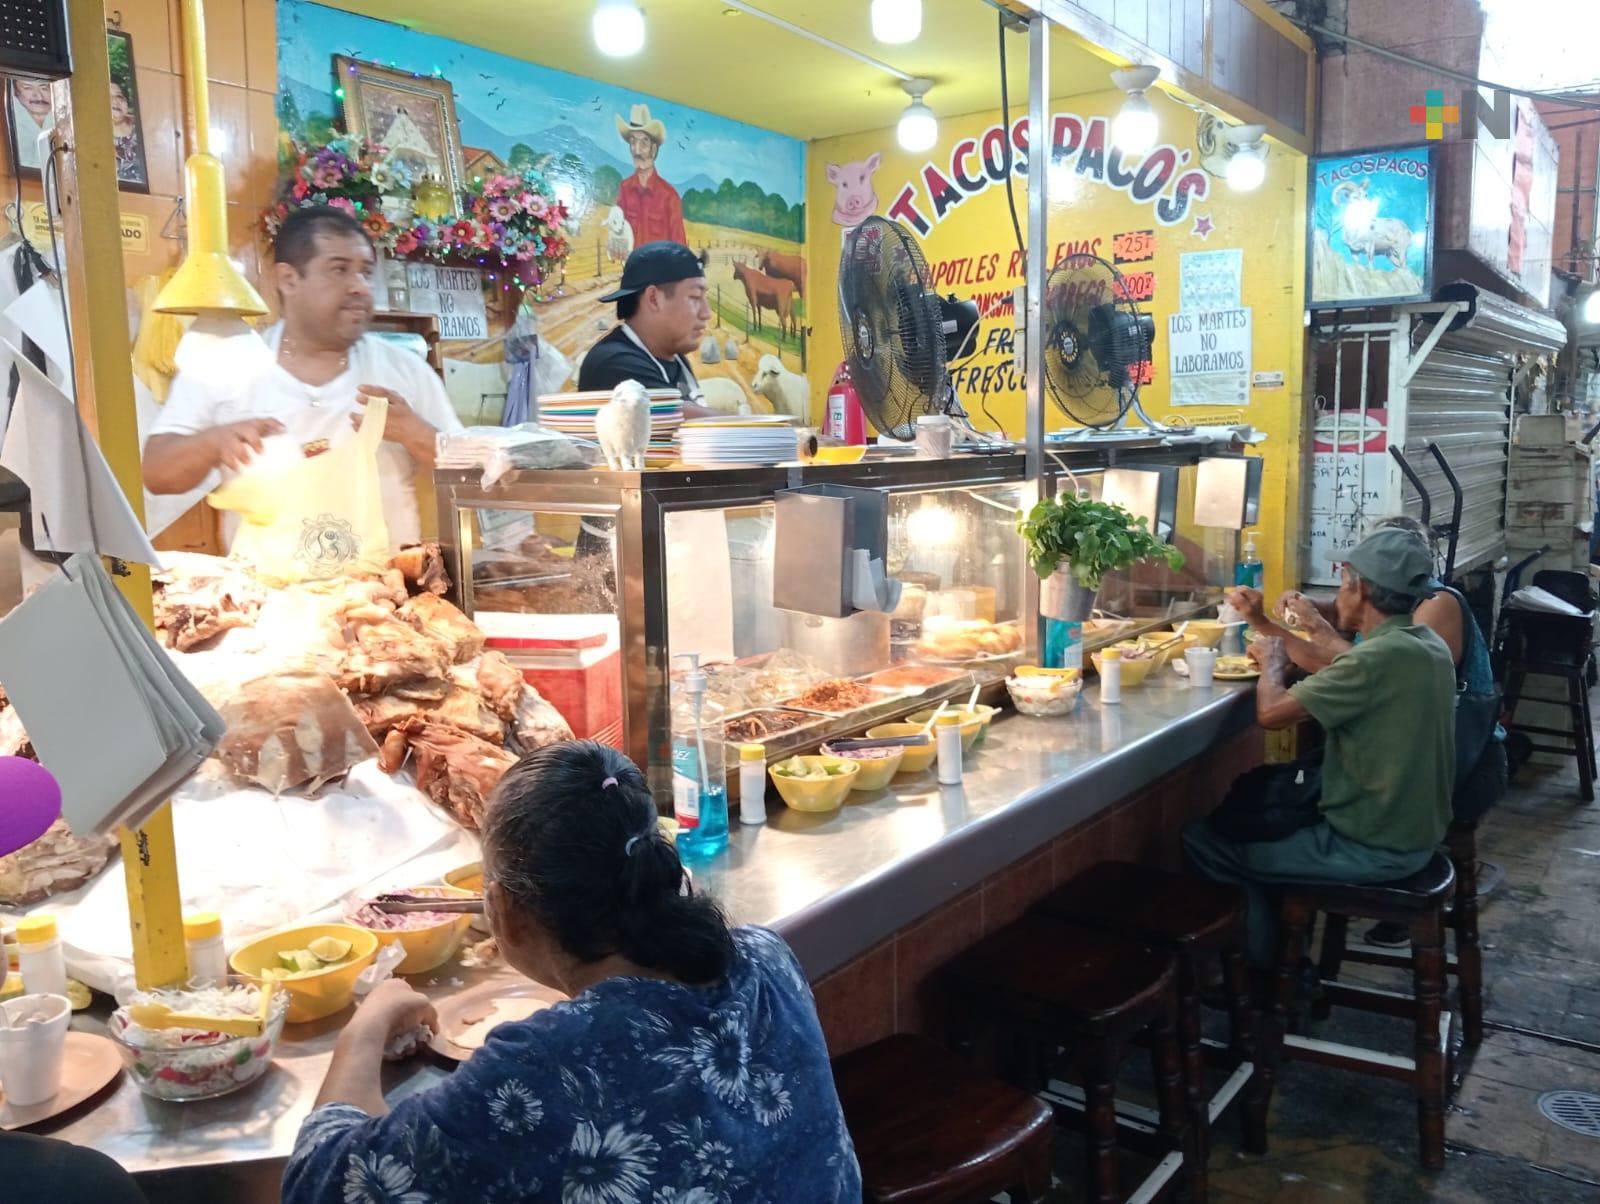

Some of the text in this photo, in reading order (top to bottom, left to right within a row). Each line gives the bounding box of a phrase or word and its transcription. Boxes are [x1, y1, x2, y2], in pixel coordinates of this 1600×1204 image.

[410, 267, 478, 291] LOS MARTES
[917, 252, 1000, 289] IPOTLES
[438, 292, 455, 314] NO
[438, 316, 481, 337] RAMOS
[1171, 309, 1247, 333] LOS MARTES
[1200, 333, 1217, 351] NO
[1175, 351, 1244, 373] LABORAMOS
